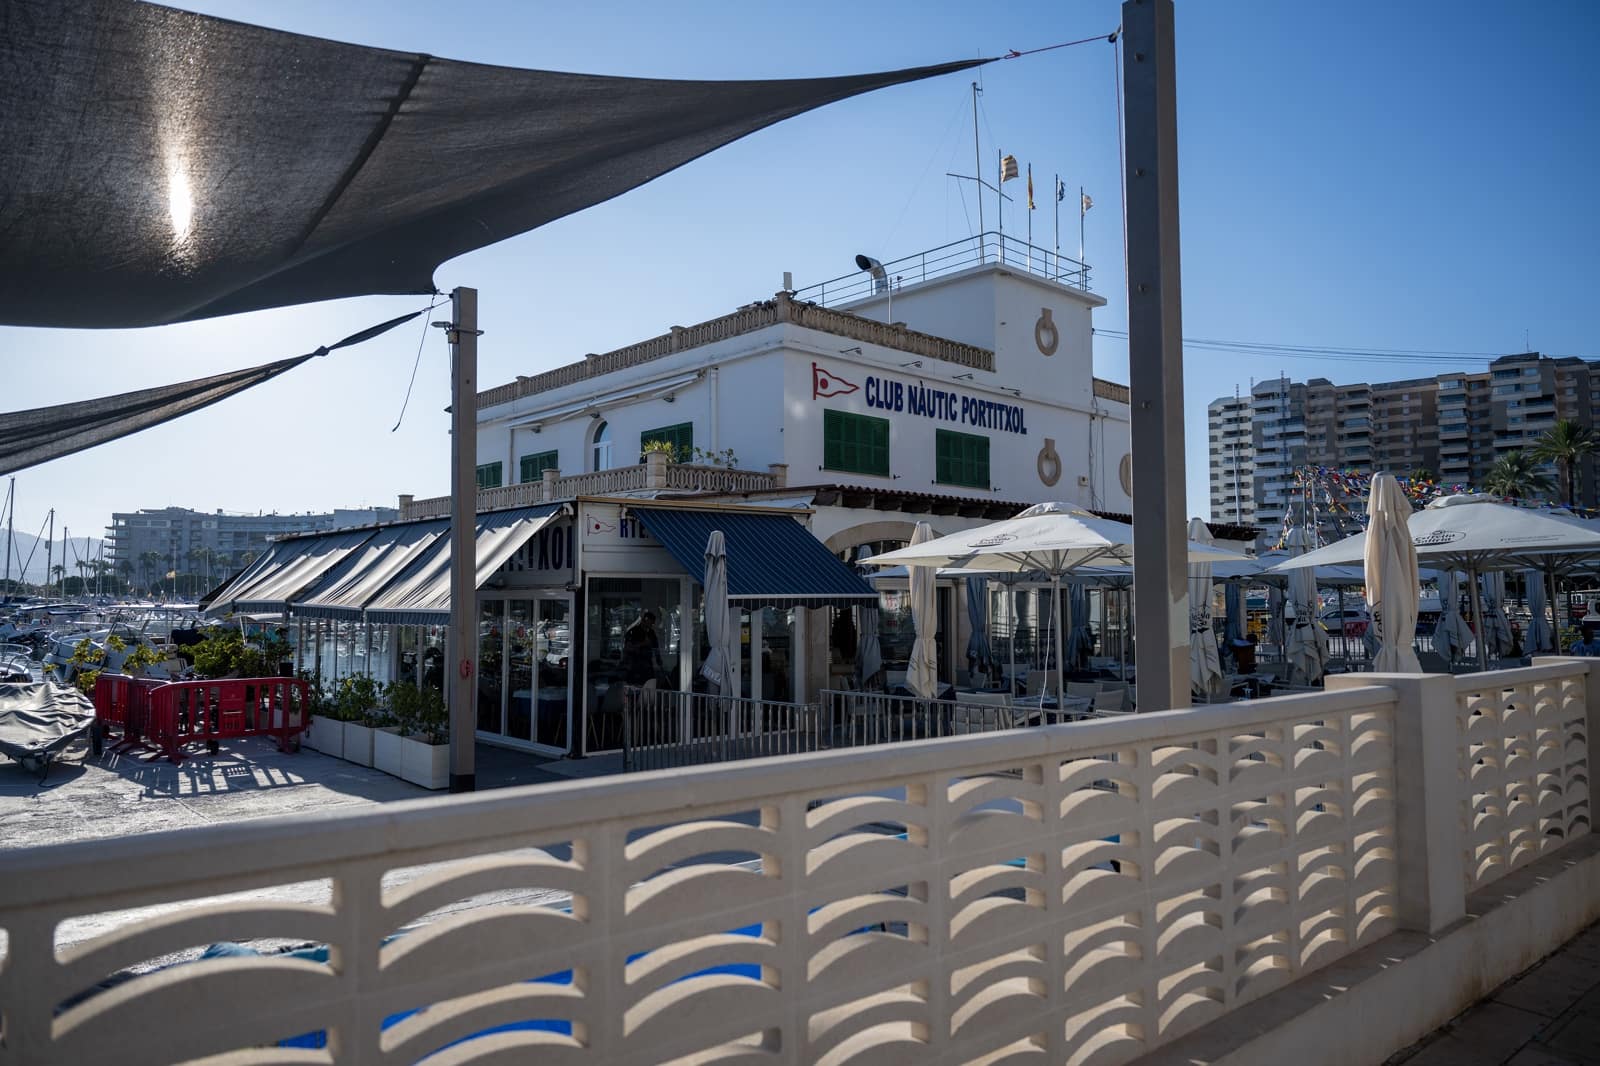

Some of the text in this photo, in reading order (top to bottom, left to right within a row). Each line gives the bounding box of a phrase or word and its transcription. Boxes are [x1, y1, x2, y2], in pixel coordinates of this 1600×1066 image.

[865, 376, 1027, 435] CLUB NÀUTIC PORTITXOL
